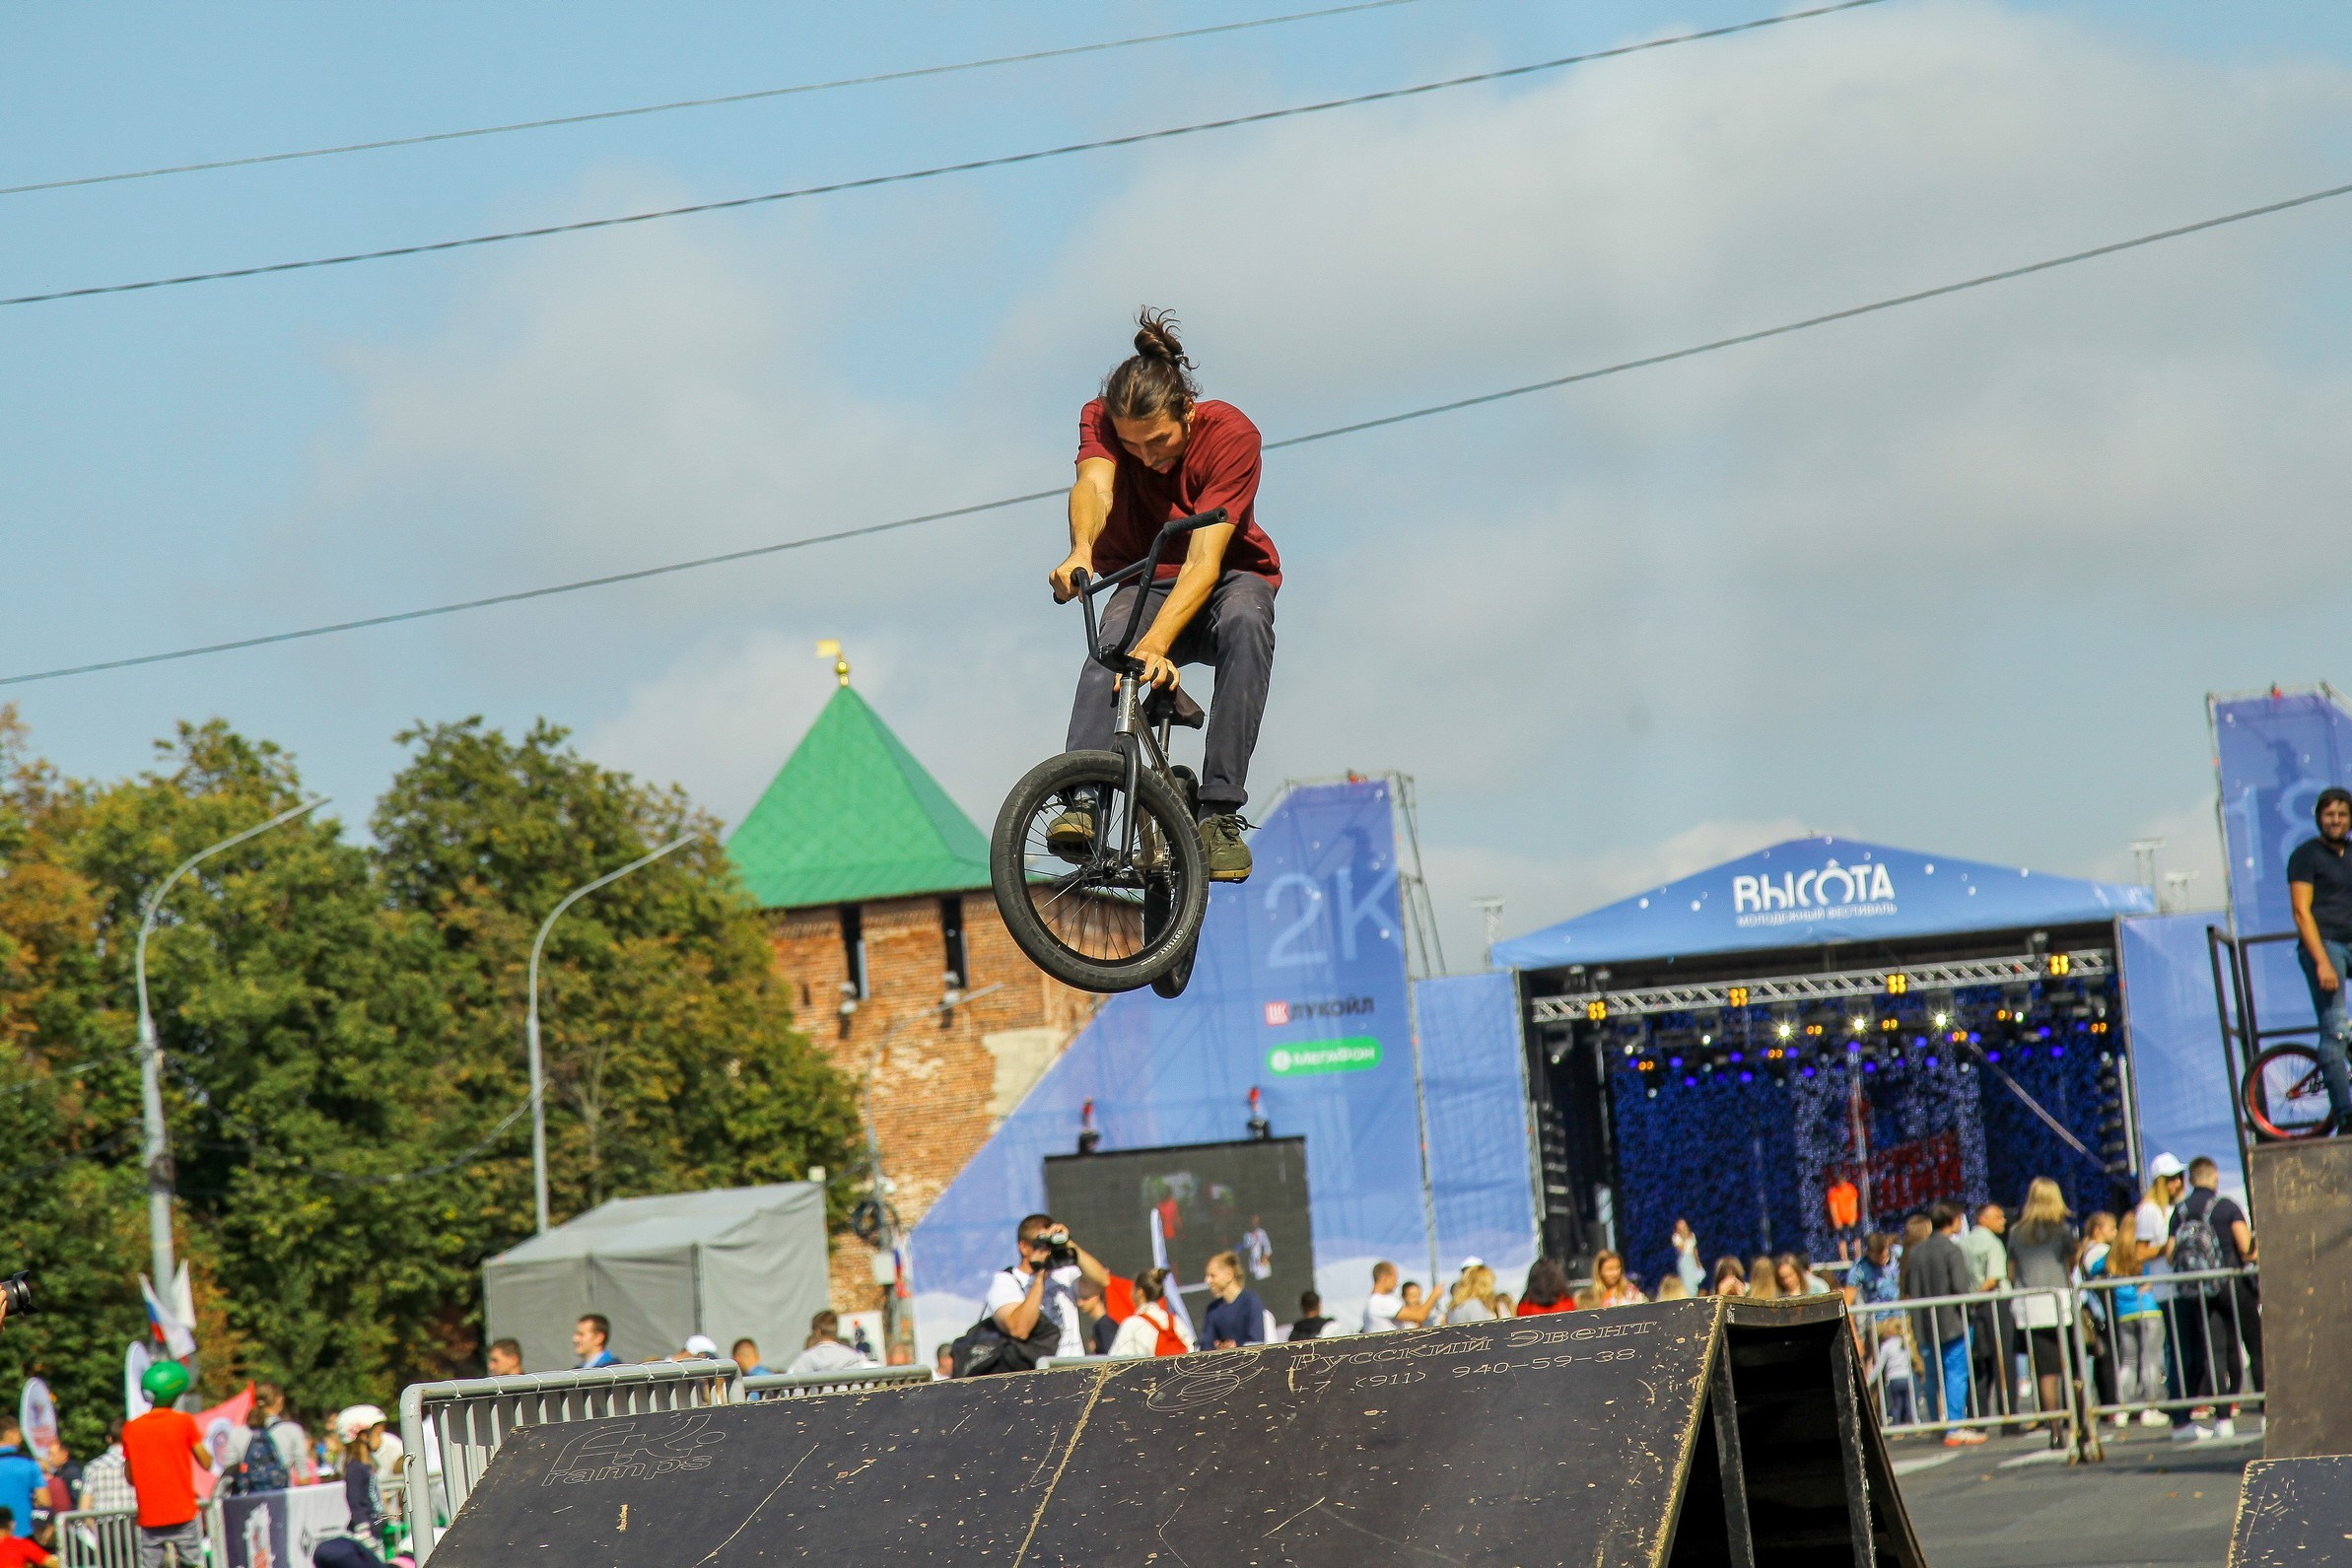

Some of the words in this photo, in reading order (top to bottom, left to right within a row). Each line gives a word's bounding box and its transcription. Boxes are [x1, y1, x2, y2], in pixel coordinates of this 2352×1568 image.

[1732, 858, 1896, 914] ВЫСОТА
[1159, 929, 1184, 955] ODYSSEY
[1290, 993, 1375, 1021] ЛУКОЙЛ
[541, 1455, 713, 1487] ramps
